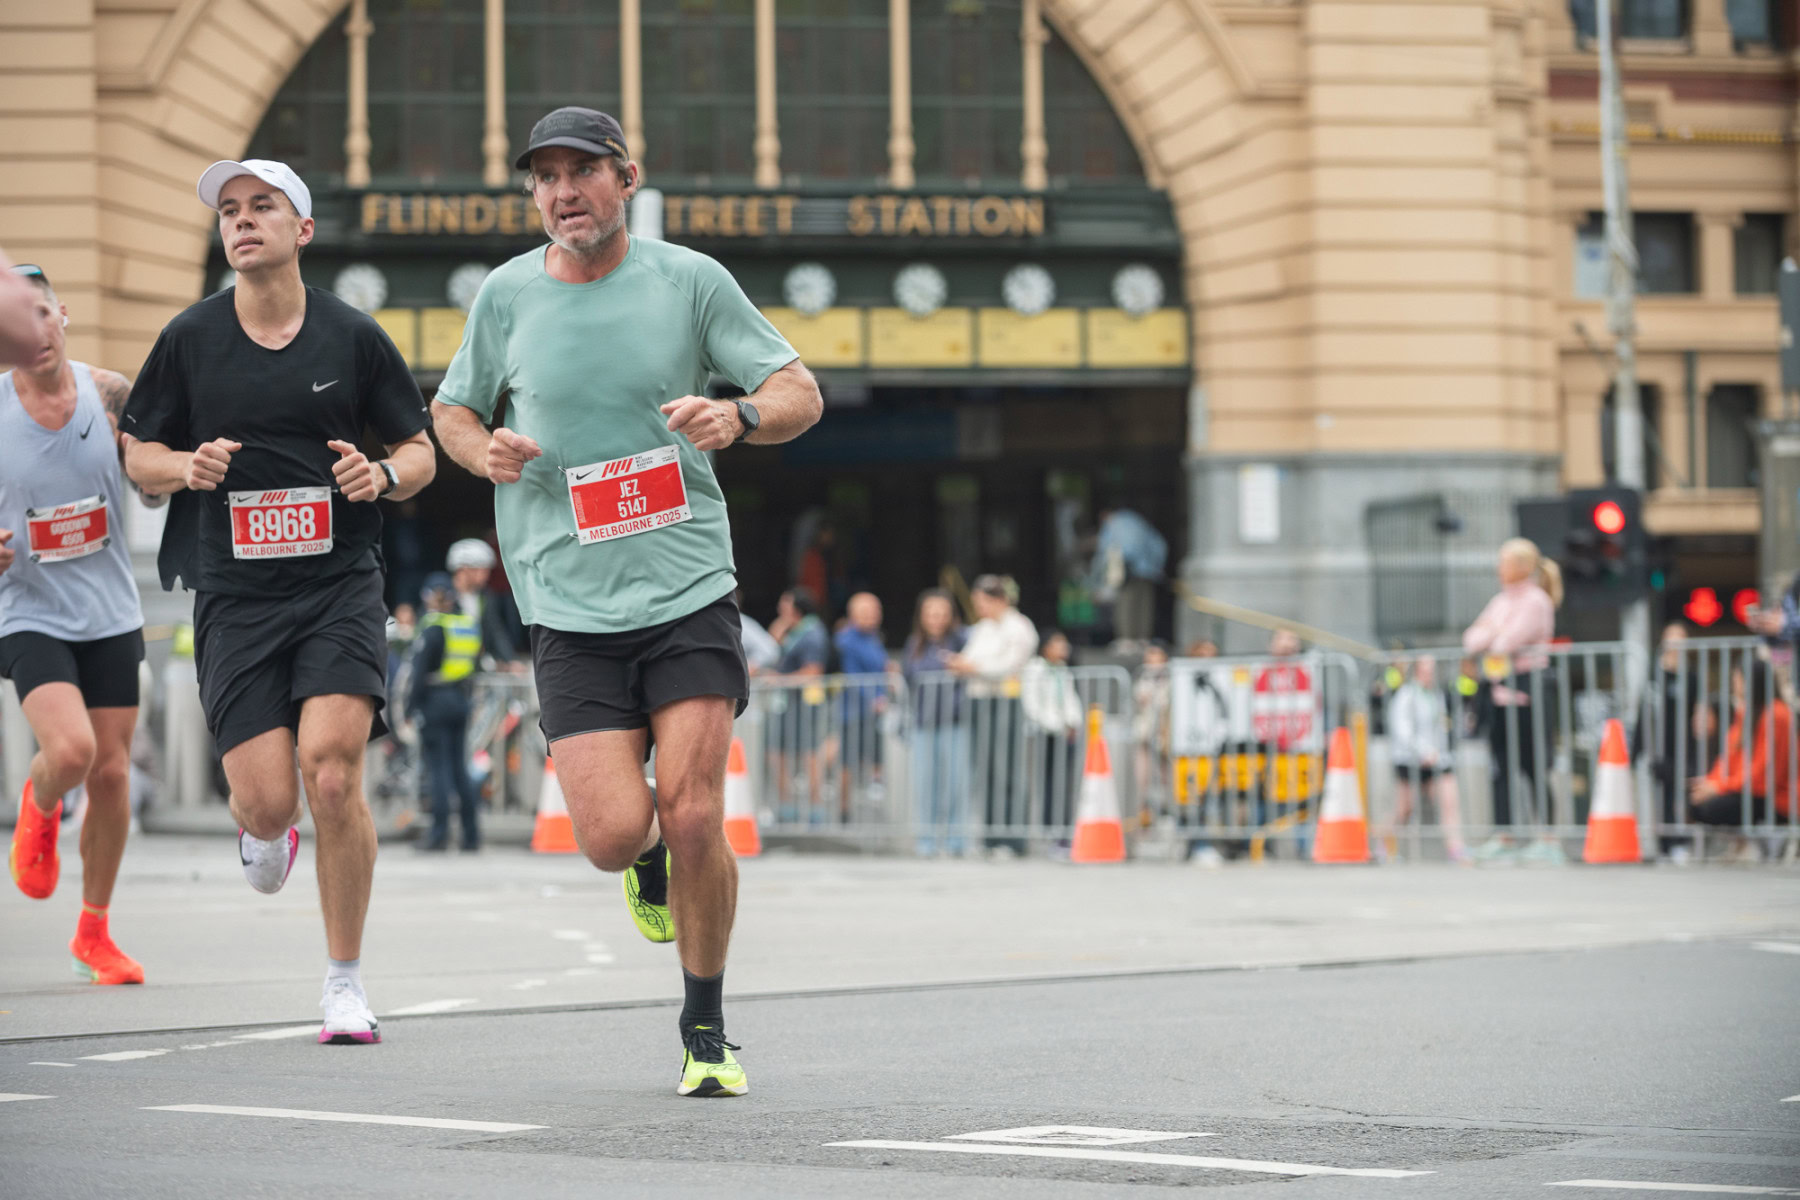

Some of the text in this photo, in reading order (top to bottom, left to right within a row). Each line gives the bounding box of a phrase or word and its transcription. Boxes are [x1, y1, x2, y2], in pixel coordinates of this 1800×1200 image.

[664, 195, 796, 236] TREET
[848, 195, 1044, 236] STATION
[619, 478, 640, 498] JEZ
[617, 496, 647, 518] 5147
[248, 505, 316, 542] 8968
[589, 509, 681, 540] MELBOURNE 2025
[242, 542, 324, 556] MELBOURNE 2025
